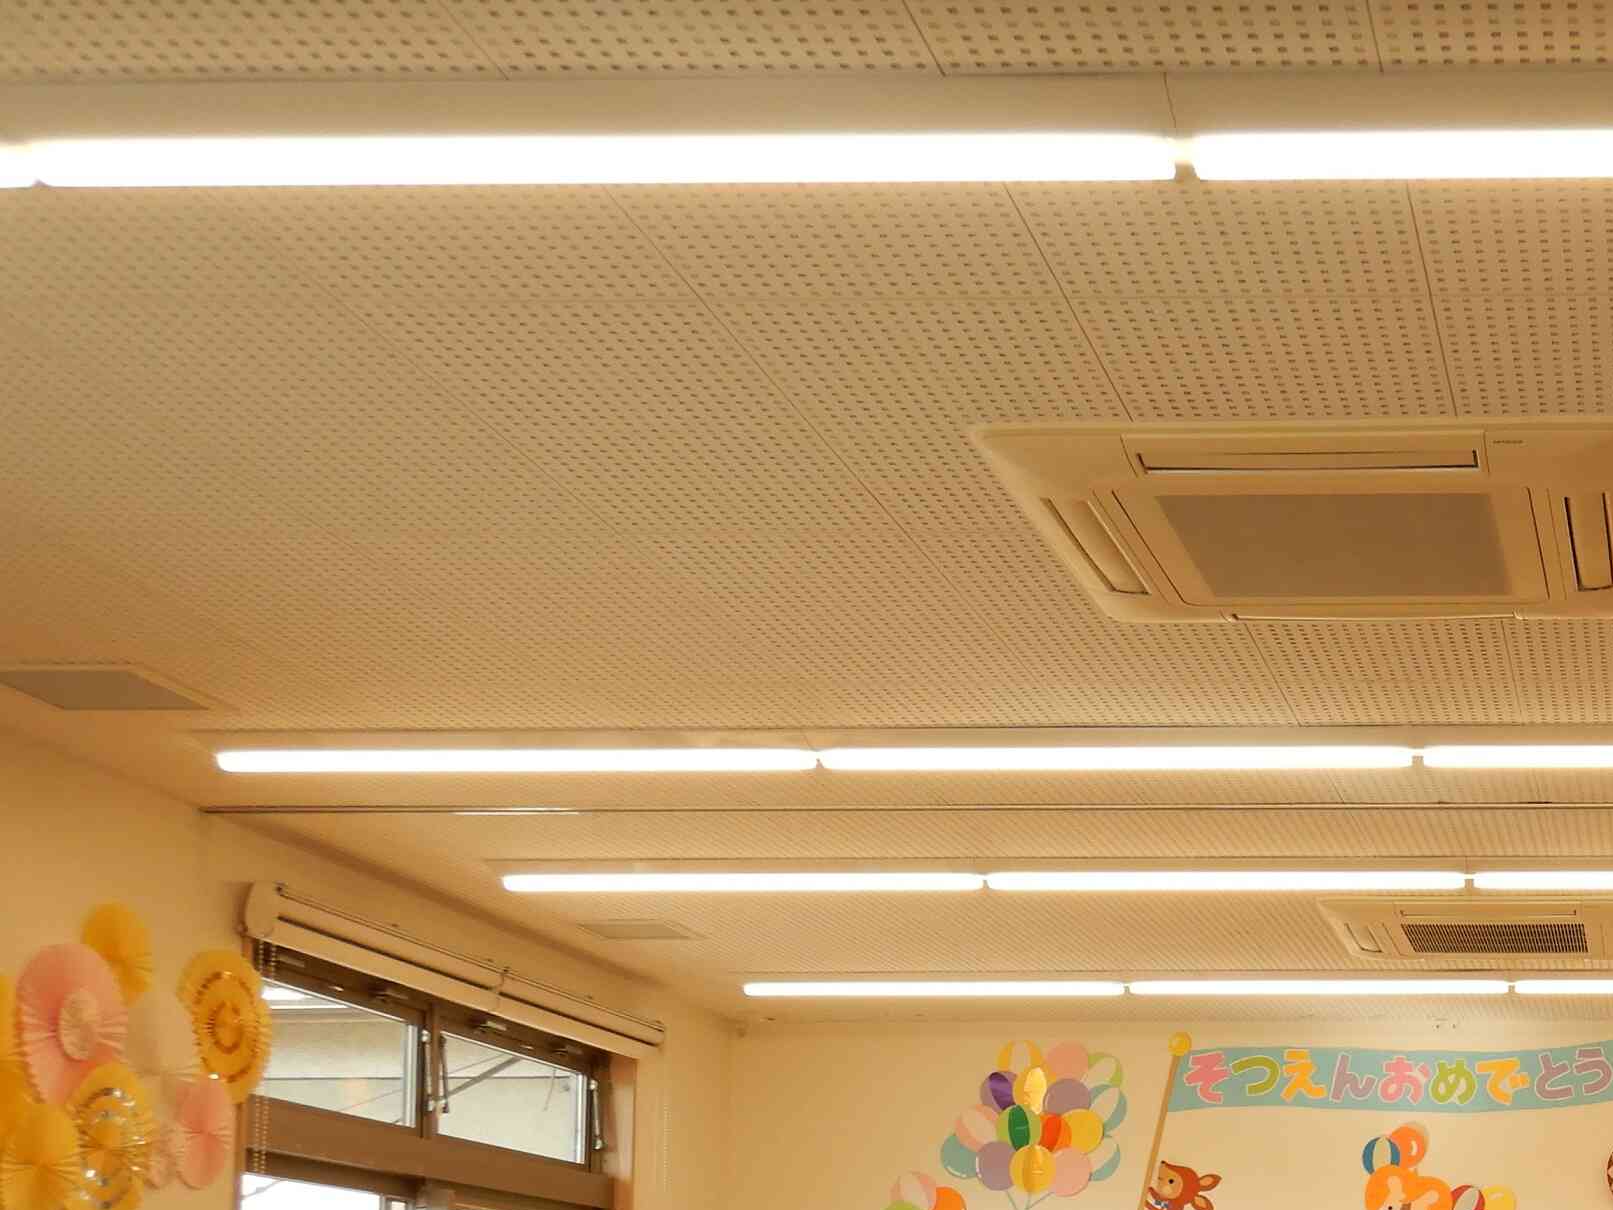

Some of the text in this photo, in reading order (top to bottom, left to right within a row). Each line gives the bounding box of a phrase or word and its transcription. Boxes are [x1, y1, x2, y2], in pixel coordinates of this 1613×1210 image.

[1184, 1047, 1613, 1104] そつえんおめでとう
